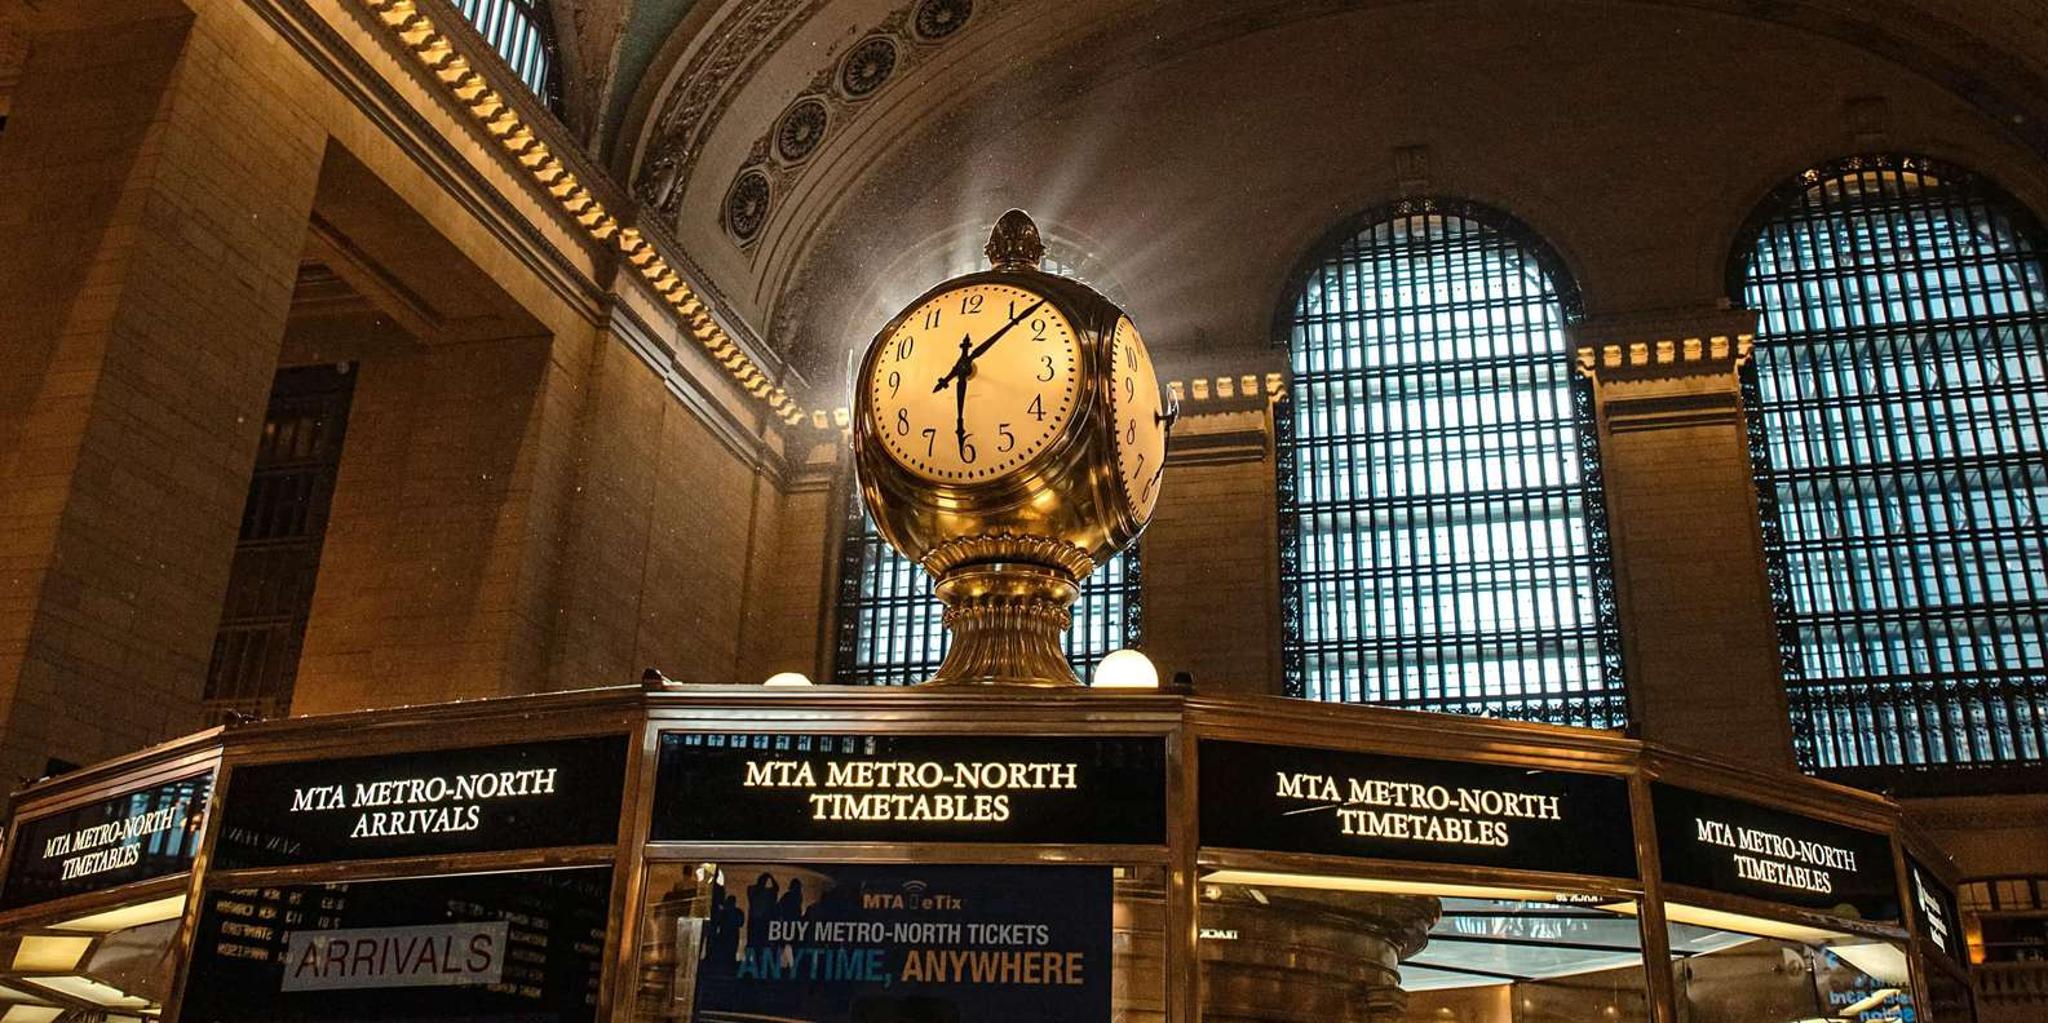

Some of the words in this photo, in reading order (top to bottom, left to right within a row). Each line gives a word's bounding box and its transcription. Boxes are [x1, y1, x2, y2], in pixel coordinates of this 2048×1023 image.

[960, 294, 983, 314] 12
[924, 308, 941, 330] 11
[1031, 319, 1047, 341] 2
[896, 335, 914, 362] 10
[1125, 345, 1138, 372] 10
[1036, 356, 1054, 382] 3
[889, 371, 900, 399] 9
[1125, 376, 1134, 404] 9
[1027, 393, 1047, 421] 4
[897, 408, 909, 436] 8
[1126, 418, 1136, 445] 8
[922, 428, 936, 457] 7
[960, 433, 976, 464] 6
[997, 423, 1015, 453] 5
[1133, 453, 1145, 480] 7
[1142, 478, 1153, 503] 6
[744, 760, 817, 788] MTA
[825, 761, 1078, 789] METRO-NORTH
[290, 786, 346, 812] MTA
[351, 768, 558, 808] METRO-NORTH
[1276, 771, 1342, 802] MTA
[1347, 778, 1561, 821] METRO-NORTH
[350, 805, 480, 838] ARRIVALS
[809, 793, 1010, 822] TIMETABLES
[43, 833, 71, 859] MTA
[72, 806, 176, 852] METRO-NORTH
[1337, 808, 1510, 847] TIMETABLES
[1695, 818, 1736, 848] MTA
[1737, 826, 1858, 872] METRO-NORTH
[61, 842, 140, 881] TIMETABLES
[1733, 853, 1832, 894] TIMETABLES
[863, 894, 904, 910] MTA
[922, 894, 963, 910] eTix
[768, 920, 809, 942] BUY
[814, 922, 961, 944] METRO-NORTH
[966, 924, 1050, 945] TICKETS
[295, 933, 493, 978] ARRIVALS
[736, 945, 893, 988] ANYTIME,
[901, 950, 1085, 985] ANYWHERE
